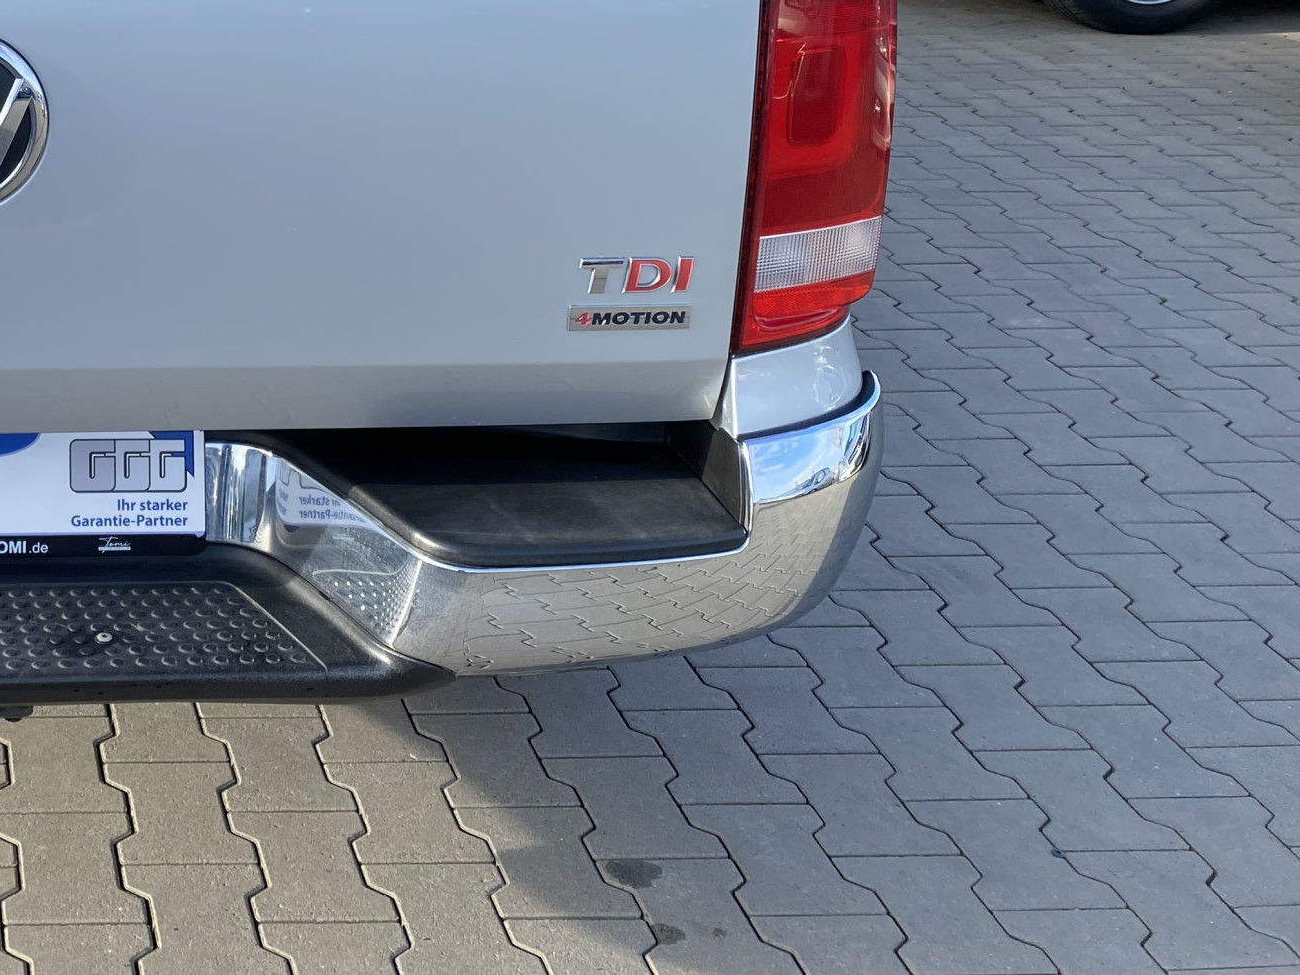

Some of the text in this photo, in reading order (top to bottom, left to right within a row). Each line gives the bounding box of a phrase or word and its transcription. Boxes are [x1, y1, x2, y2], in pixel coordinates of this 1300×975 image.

[579, 256, 695, 294] TDI
[575, 311, 686, 326] 4MOTION
[117, 499, 188, 511] Ihr starker
[71, 514, 188, 527] Garantie-Partner
